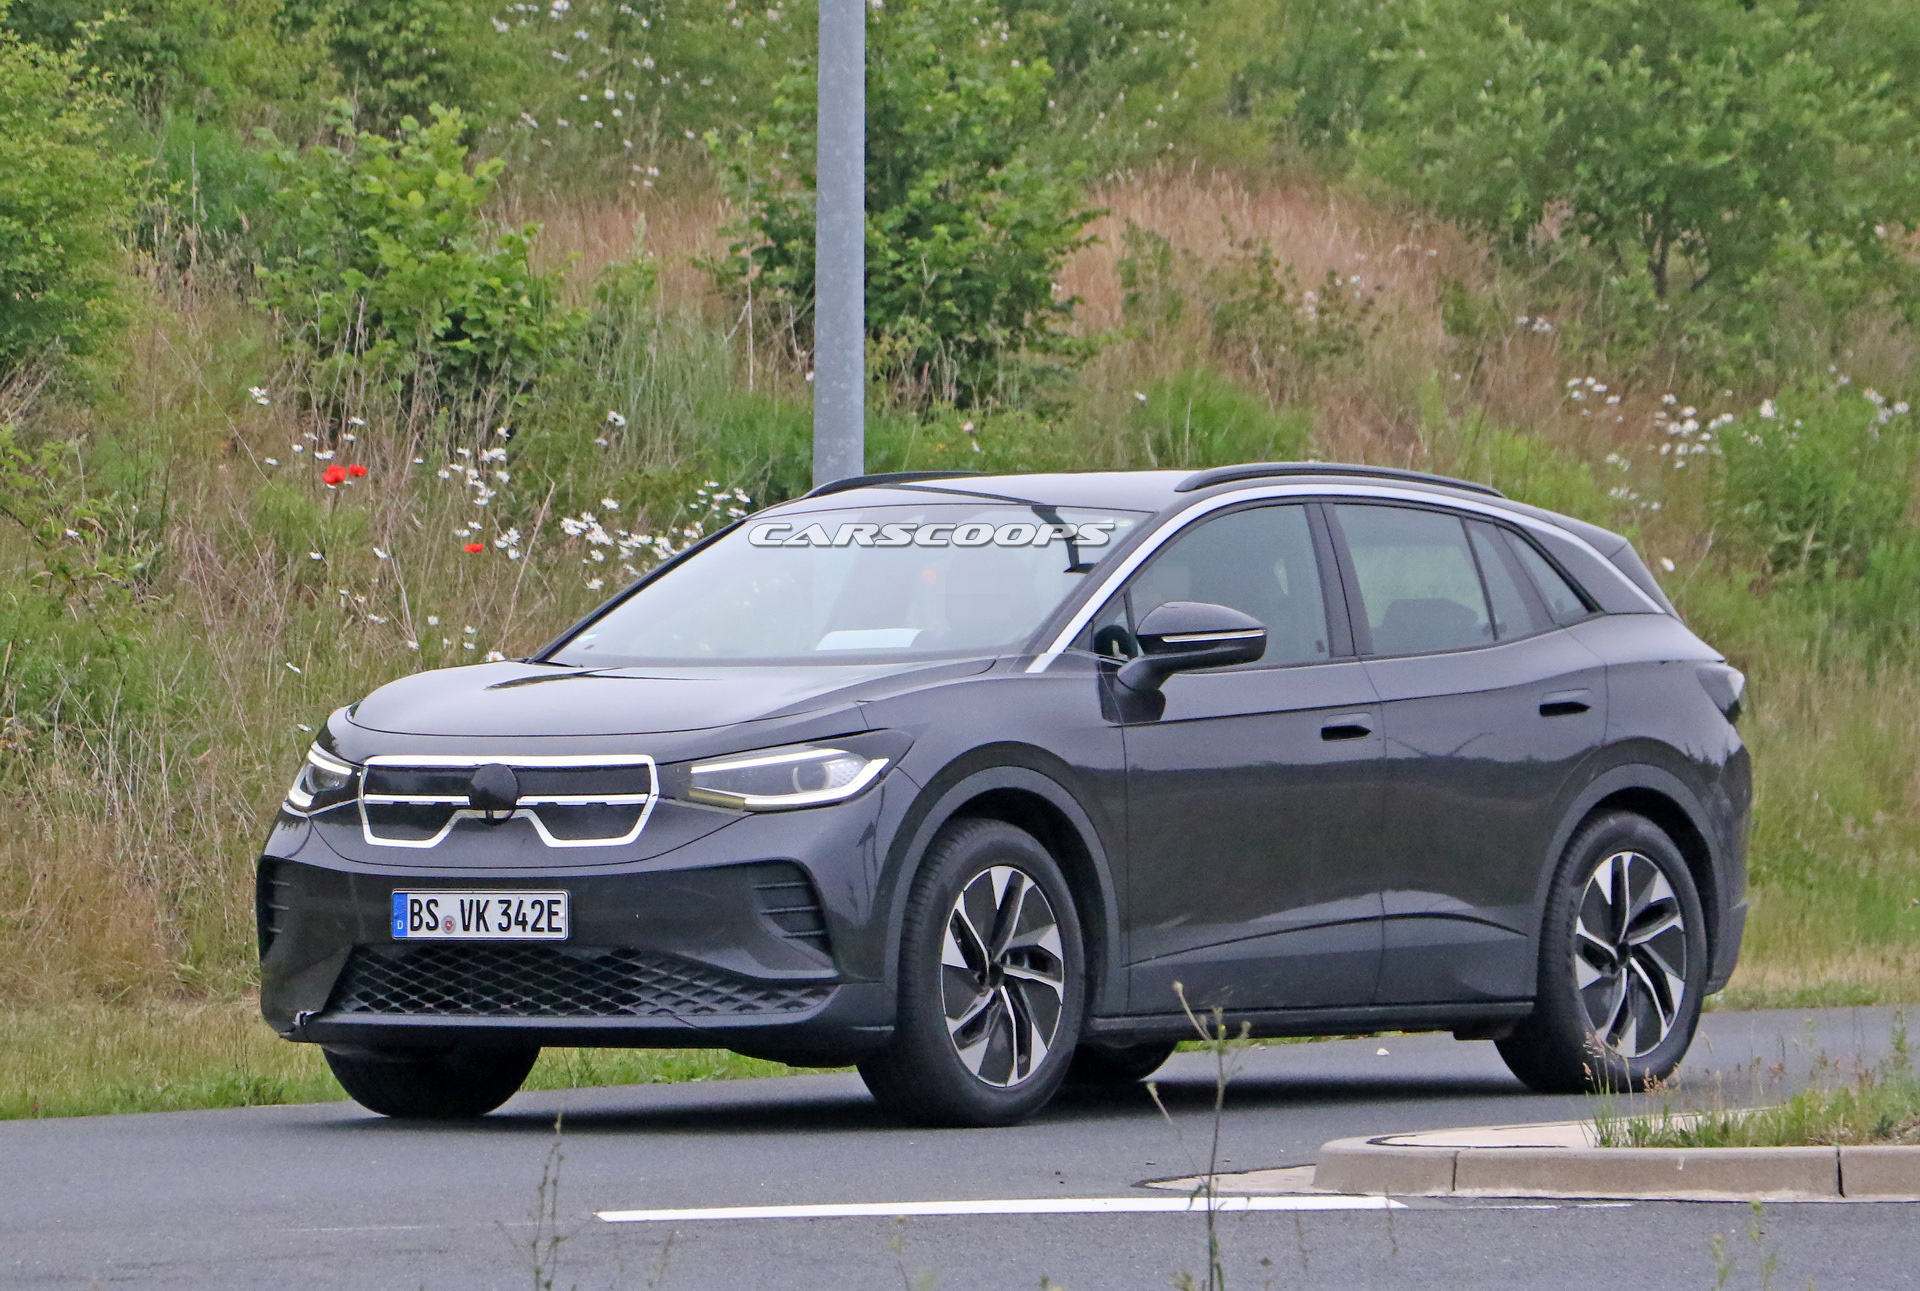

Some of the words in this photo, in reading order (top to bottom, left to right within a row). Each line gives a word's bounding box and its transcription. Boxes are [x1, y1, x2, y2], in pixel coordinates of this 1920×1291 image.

[397, 921, 404, 930] D
[409, 898, 440, 932] BS
[459, 898, 490, 933] VK
[497, 898, 563, 933] 342E
